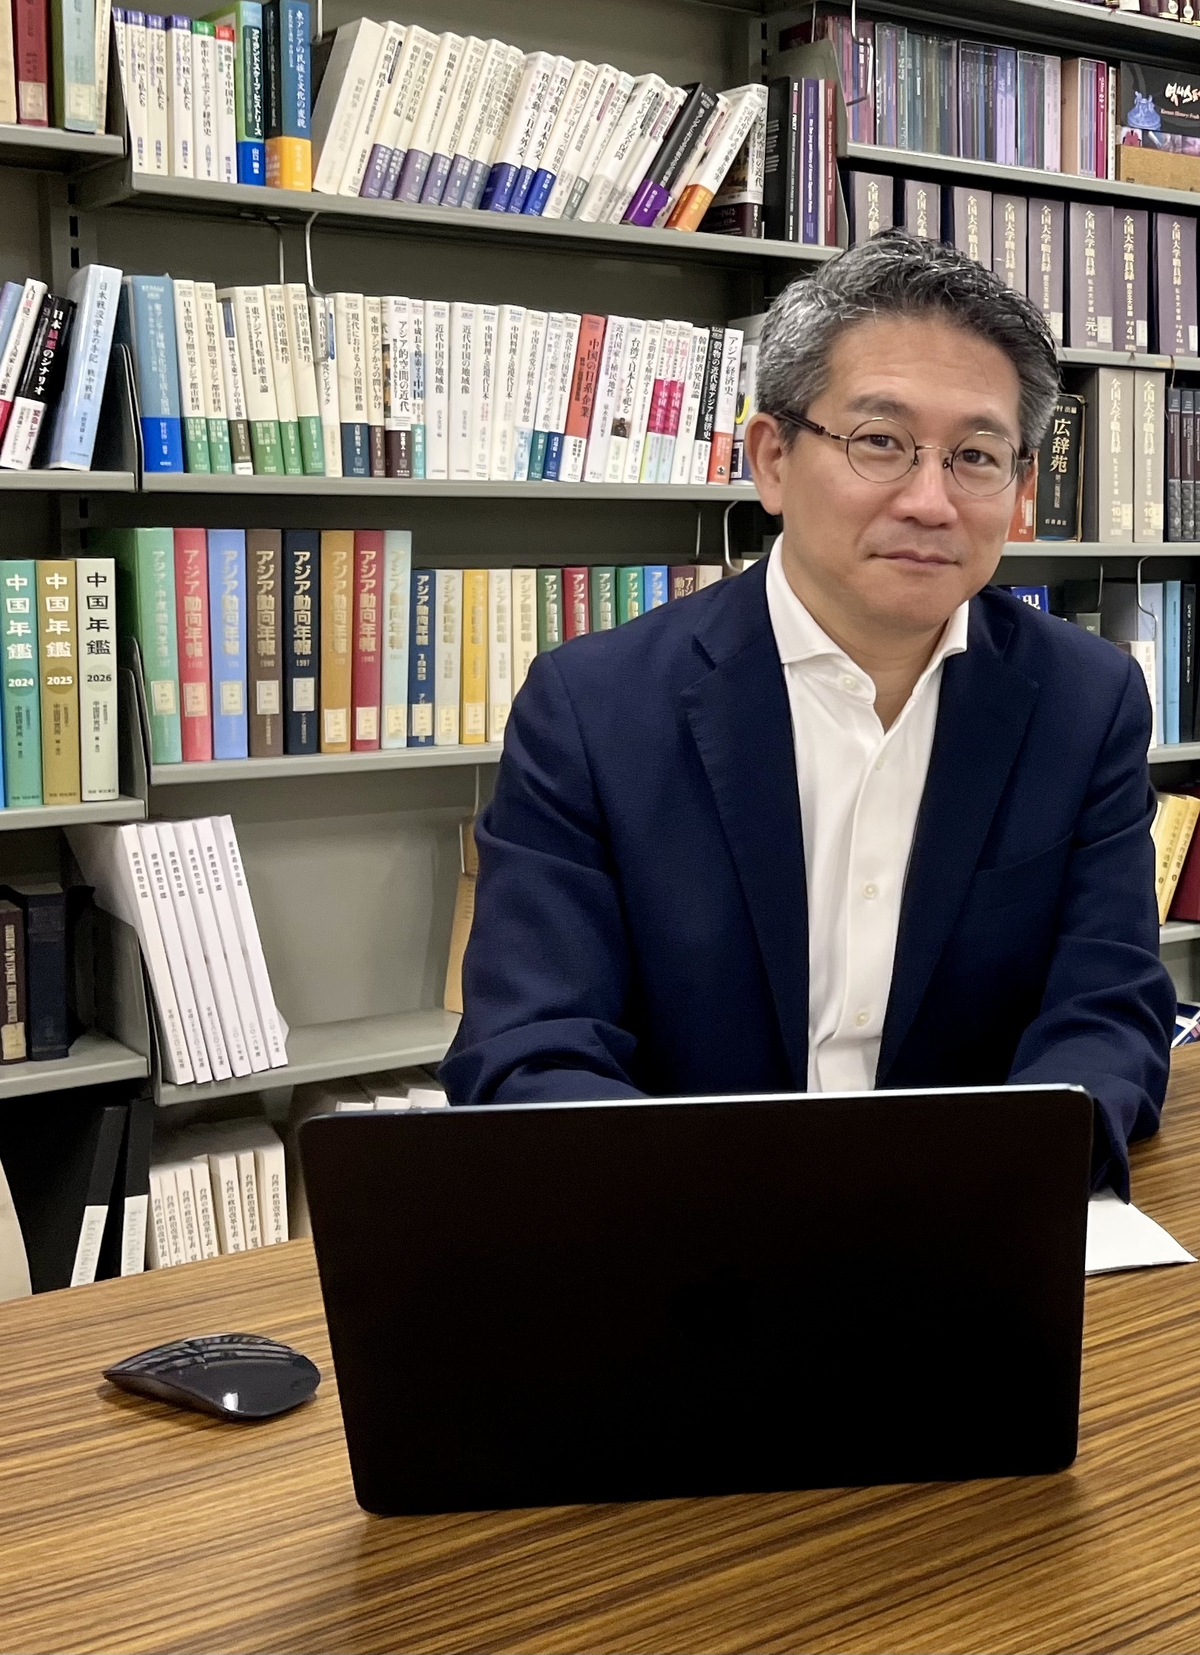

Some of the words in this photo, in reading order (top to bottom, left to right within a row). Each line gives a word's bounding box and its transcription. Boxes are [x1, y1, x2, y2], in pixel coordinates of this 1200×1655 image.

[1041, 205, 1052, 273] 全国大学職員録
[1084, 210, 1096, 276] 全国大学職員録
[1123, 215, 1135, 281] 全国大学職員録
[1172, 221, 1182, 286] 全国大学職員録
[350, 312, 364, 412] 現代における人の国際移動
[399, 320, 412, 413] アジア的空間の近代
[434, 322, 446, 395] 近代中国の地域像
[459, 324, 471, 395] 近代中国の地域像
[580, 338, 601, 418] 中国の日系企業
[725, 336, 740, 397] アジア経済史
[1049, 418, 1072, 474] 広辞苑
[1110, 378, 1122, 455] 全国大学職員録
[1143, 380, 1155, 456] 全国大学職員録
[6, 573, 33, 660] 中国年鑑
[45, 572, 72, 659] 中国年鑑
[86, 571, 111, 656] 中国年鑑
[183, 550, 203, 657] アジア動向年報
[256, 550, 276, 657] アジア動向年報
[293, 550, 313, 656] アジア動向年報
[358, 550, 377, 652] アジア動向年報
[416, 574, 430, 646] アジア動向年報
[545, 574, 559, 643] アジア動向年報
[573, 574, 587, 639] アジア動向年
[8, 678, 34, 688] 2024
[47, 675, 73, 686] 2025
[87, 673, 112, 684] 2026
